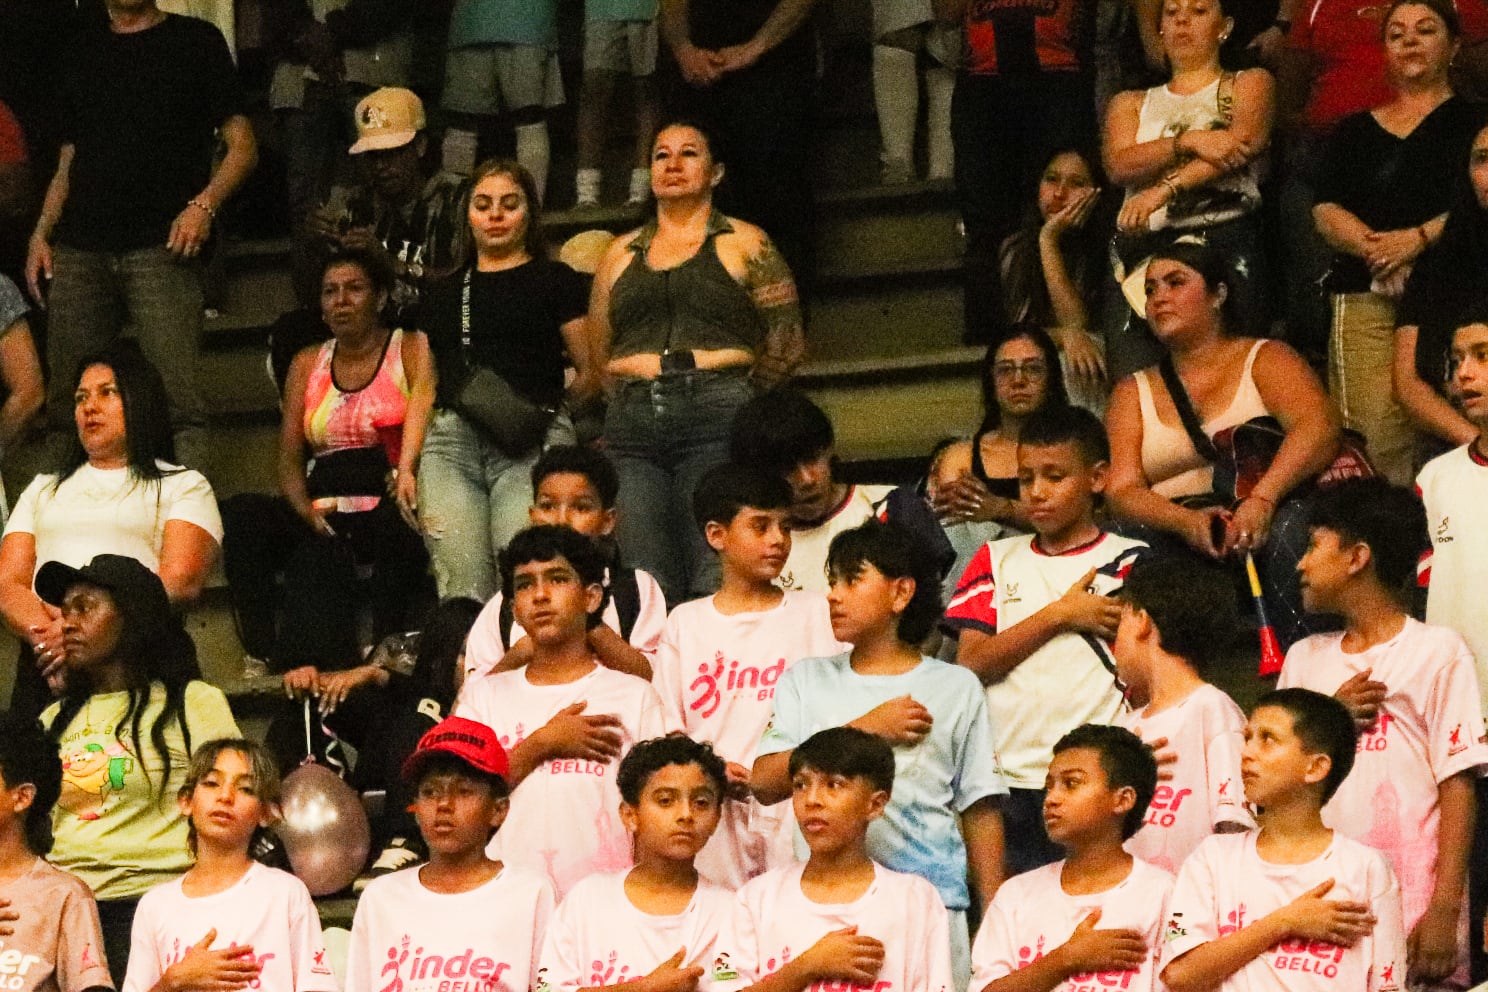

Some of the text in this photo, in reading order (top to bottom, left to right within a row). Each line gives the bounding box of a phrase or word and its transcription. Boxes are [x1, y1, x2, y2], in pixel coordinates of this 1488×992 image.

[727, 658, 786, 691] ind
[551, 761, 605, 777] BELLO
[410, 946, 511, 983] inder
[1274, 956, 1338, 978] BELLO
